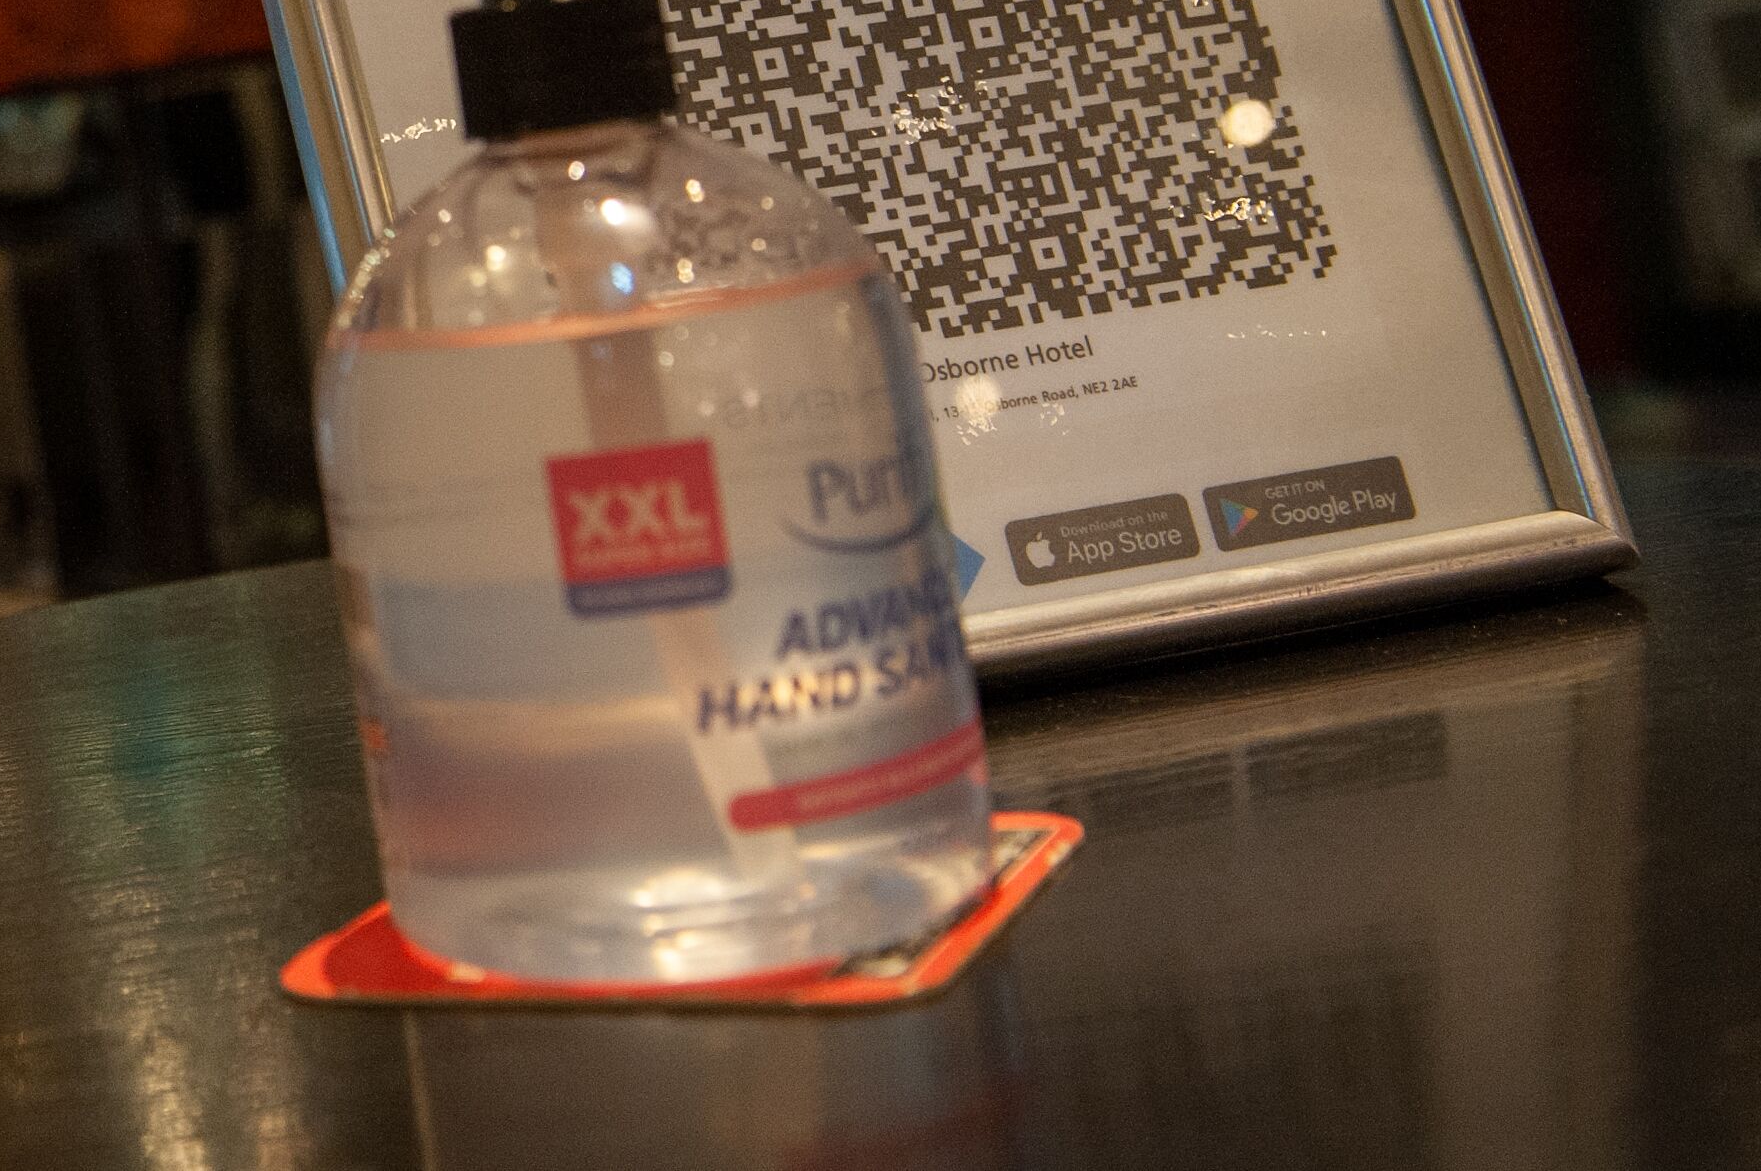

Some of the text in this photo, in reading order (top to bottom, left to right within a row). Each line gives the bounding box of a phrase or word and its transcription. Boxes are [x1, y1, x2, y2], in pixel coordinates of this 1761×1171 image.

[1025, 335, 1094, 367] Hotel
[1042, 385, 1080, 403] Road,
[1083, 379, 1109, 396] NE2
[1113, 375, 1139, 391] 2AE
[1265, 483, 1288, 500] GET
[1304, 478, 1326, 494] ON
[569, 478, 711, 542] XXL
[1060, 513, 1127, 539] Download
[1146, 509, 1169, 524] the
[1271, 488, 1398, 527] Google Play
[1066, 526, 1183, 566] App Store
[696, 660, 862, 734] HAND
